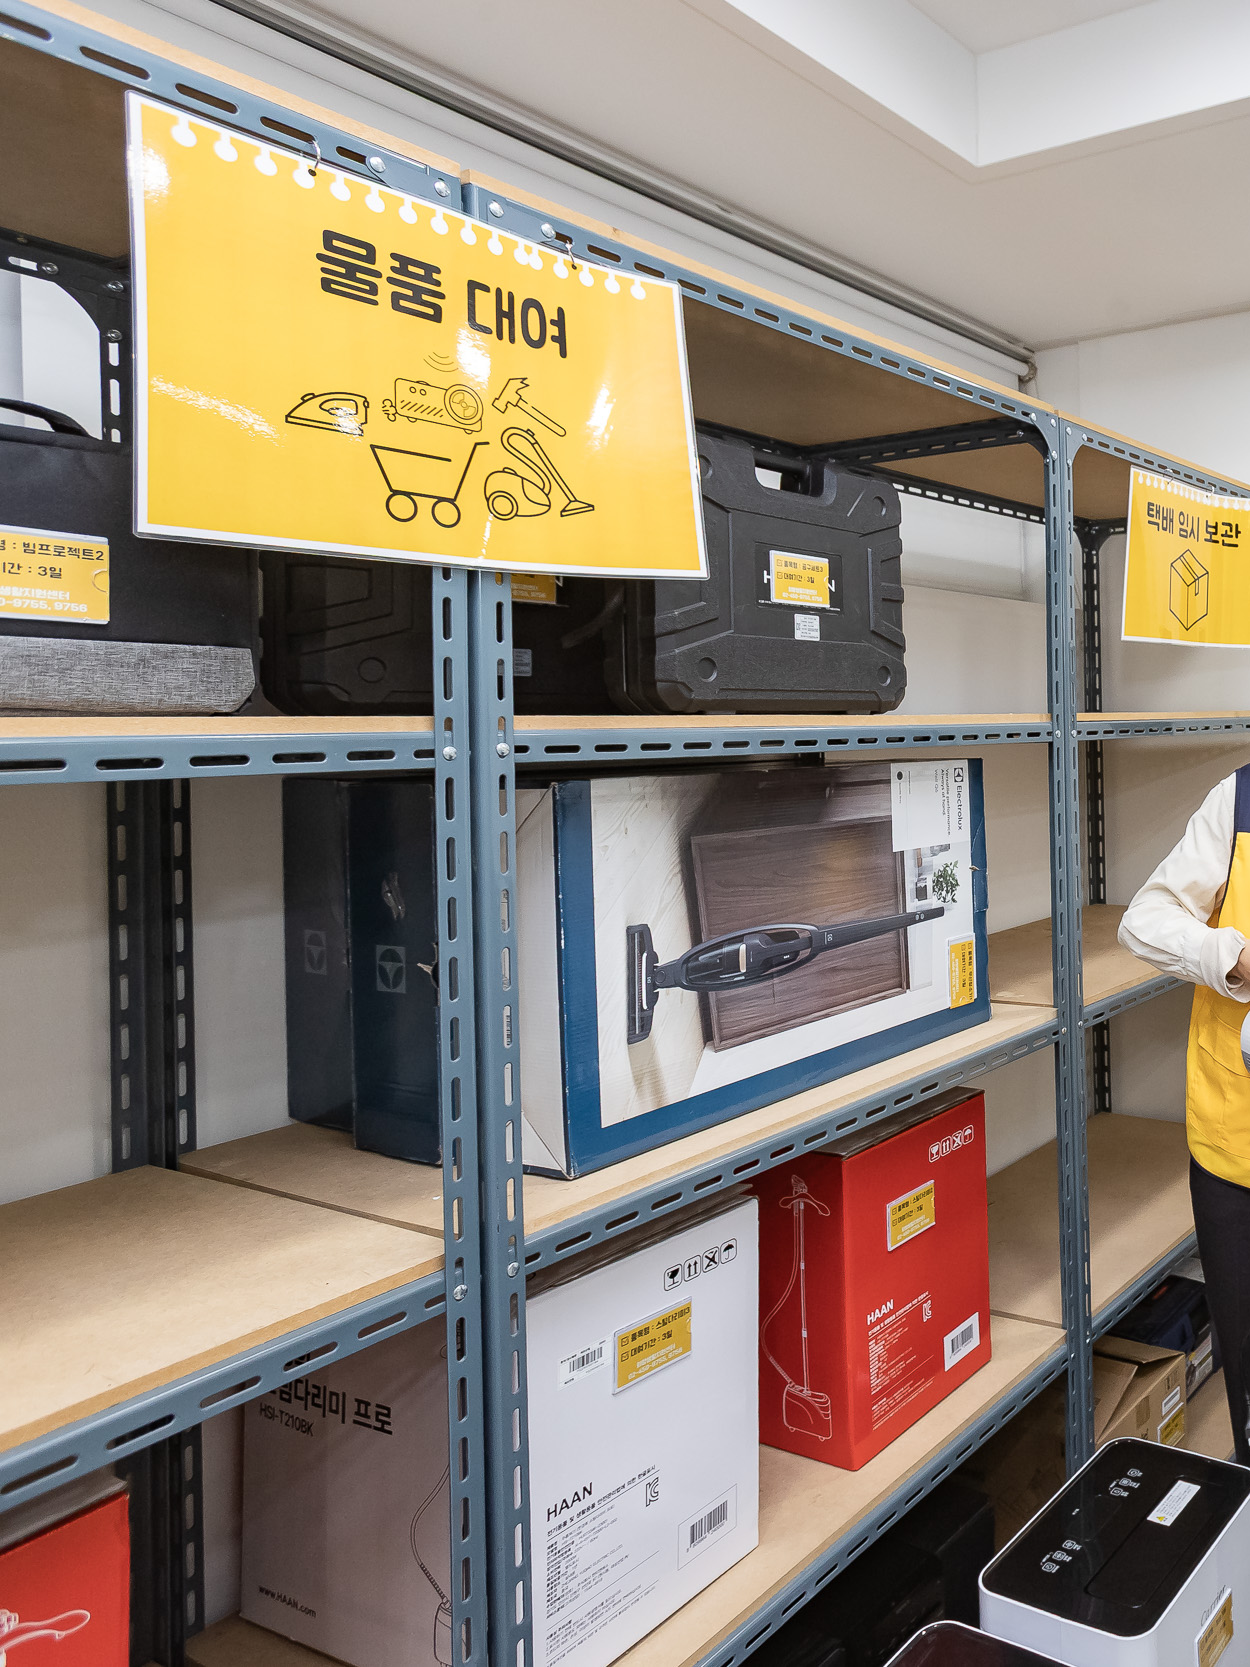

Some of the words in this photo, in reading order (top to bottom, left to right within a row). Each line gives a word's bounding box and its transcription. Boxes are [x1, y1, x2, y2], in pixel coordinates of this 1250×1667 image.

[316, 229, 446, 324] 물품
[467, 279, 568, 359] 대여
[1146, 501, 1175, 535] 택배
[1178, 510, 1200, 543] 임시
[1203, 519, 1242, 548] 보관
[22, 541, 105, 561] 빔프로젝트2
[37, 565, 62, 580] 3일
[53, 601, 89, 613] 9756
[866, 1298, 895, 1326] HAAN
[630, 1338, 657, 1357] 대여기간
[661, 1329, 673, 1340] 3일
[259, 1402, 314, 1437] HSI-T210BK
[352, 1397, 393, 1436] 프로
[546, 1481, 593, 1523] HAAN
[258, 1585, 317, 1619] www.HAAN.com
